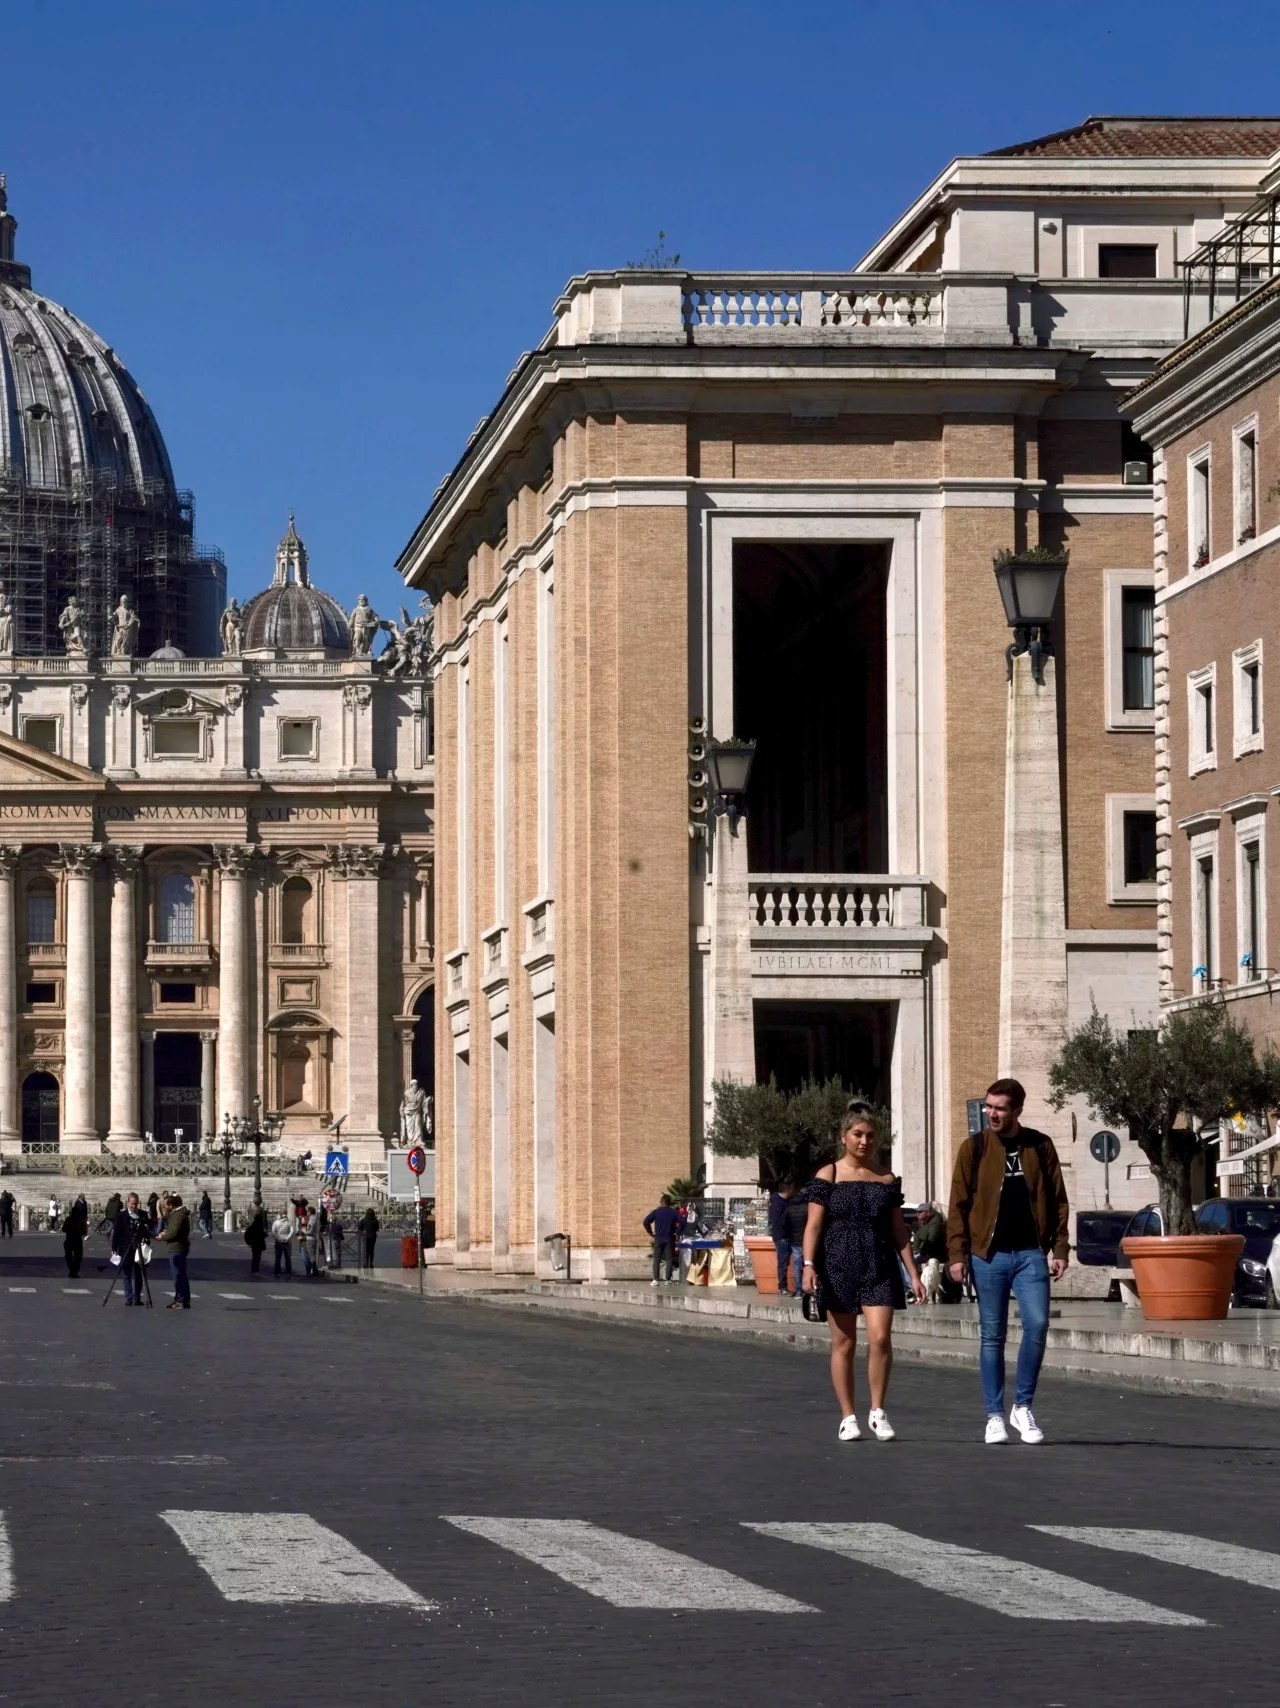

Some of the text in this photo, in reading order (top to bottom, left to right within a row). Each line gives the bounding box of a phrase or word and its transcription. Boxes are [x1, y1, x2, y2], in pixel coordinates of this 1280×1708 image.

[0, 805, 92, 819] ROMANVS
[146, 805, 185, 819] MAX
[296, 806, 342, 820] PONT
[758, 956, 834, 969] IVBILAEI
